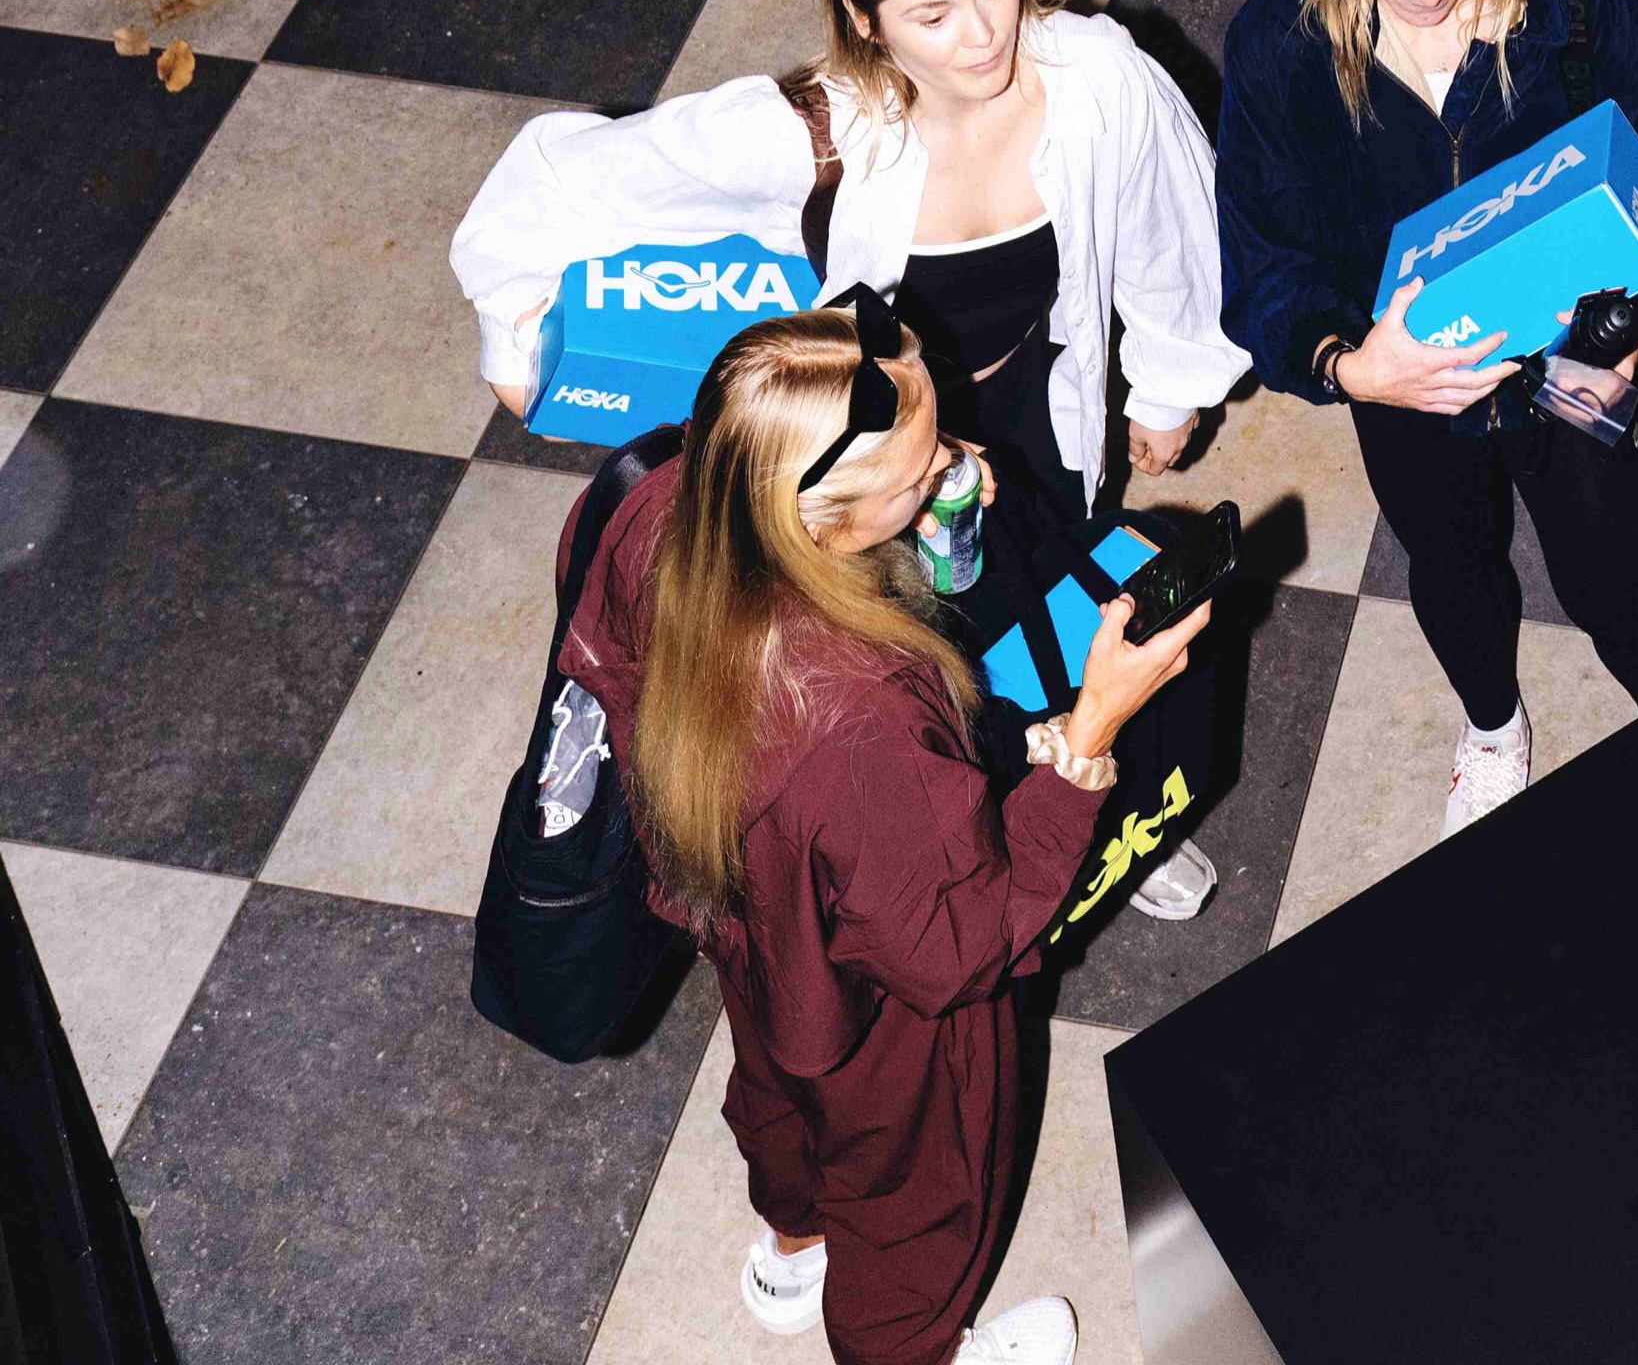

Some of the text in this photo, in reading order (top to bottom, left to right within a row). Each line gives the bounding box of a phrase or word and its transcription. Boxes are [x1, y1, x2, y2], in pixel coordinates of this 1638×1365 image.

[1399, 145, 1586, 278] HOKA
[581, 251, 800, 313] HOKA
[1420, 314, 1482, 347] OKA
[553, 385, 630, 412] HOKA
